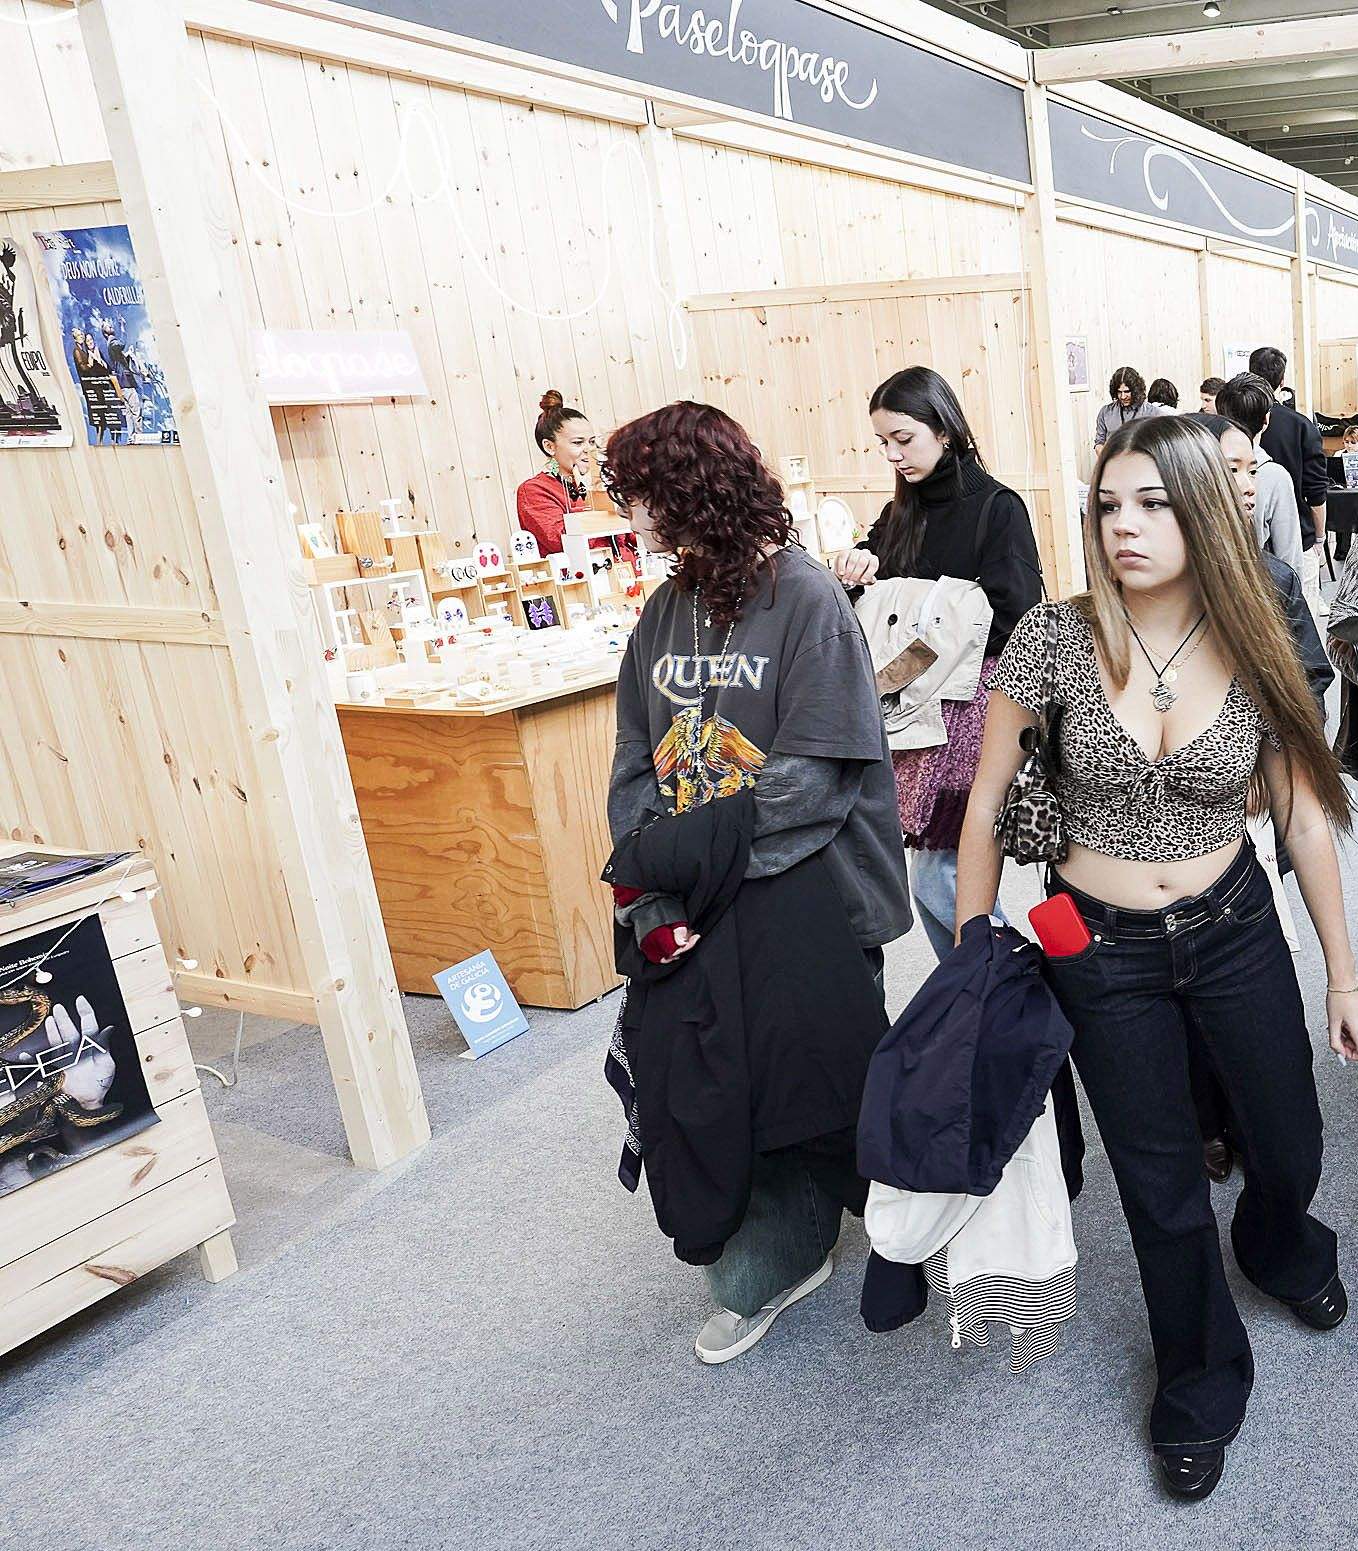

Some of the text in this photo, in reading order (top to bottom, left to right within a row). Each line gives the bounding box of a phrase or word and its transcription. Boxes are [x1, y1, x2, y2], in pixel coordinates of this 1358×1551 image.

[80, 260, 99, 278] NON
[652, 651, 770, 707] QUEEN
[0, 1034, 107, 1095] DEA
